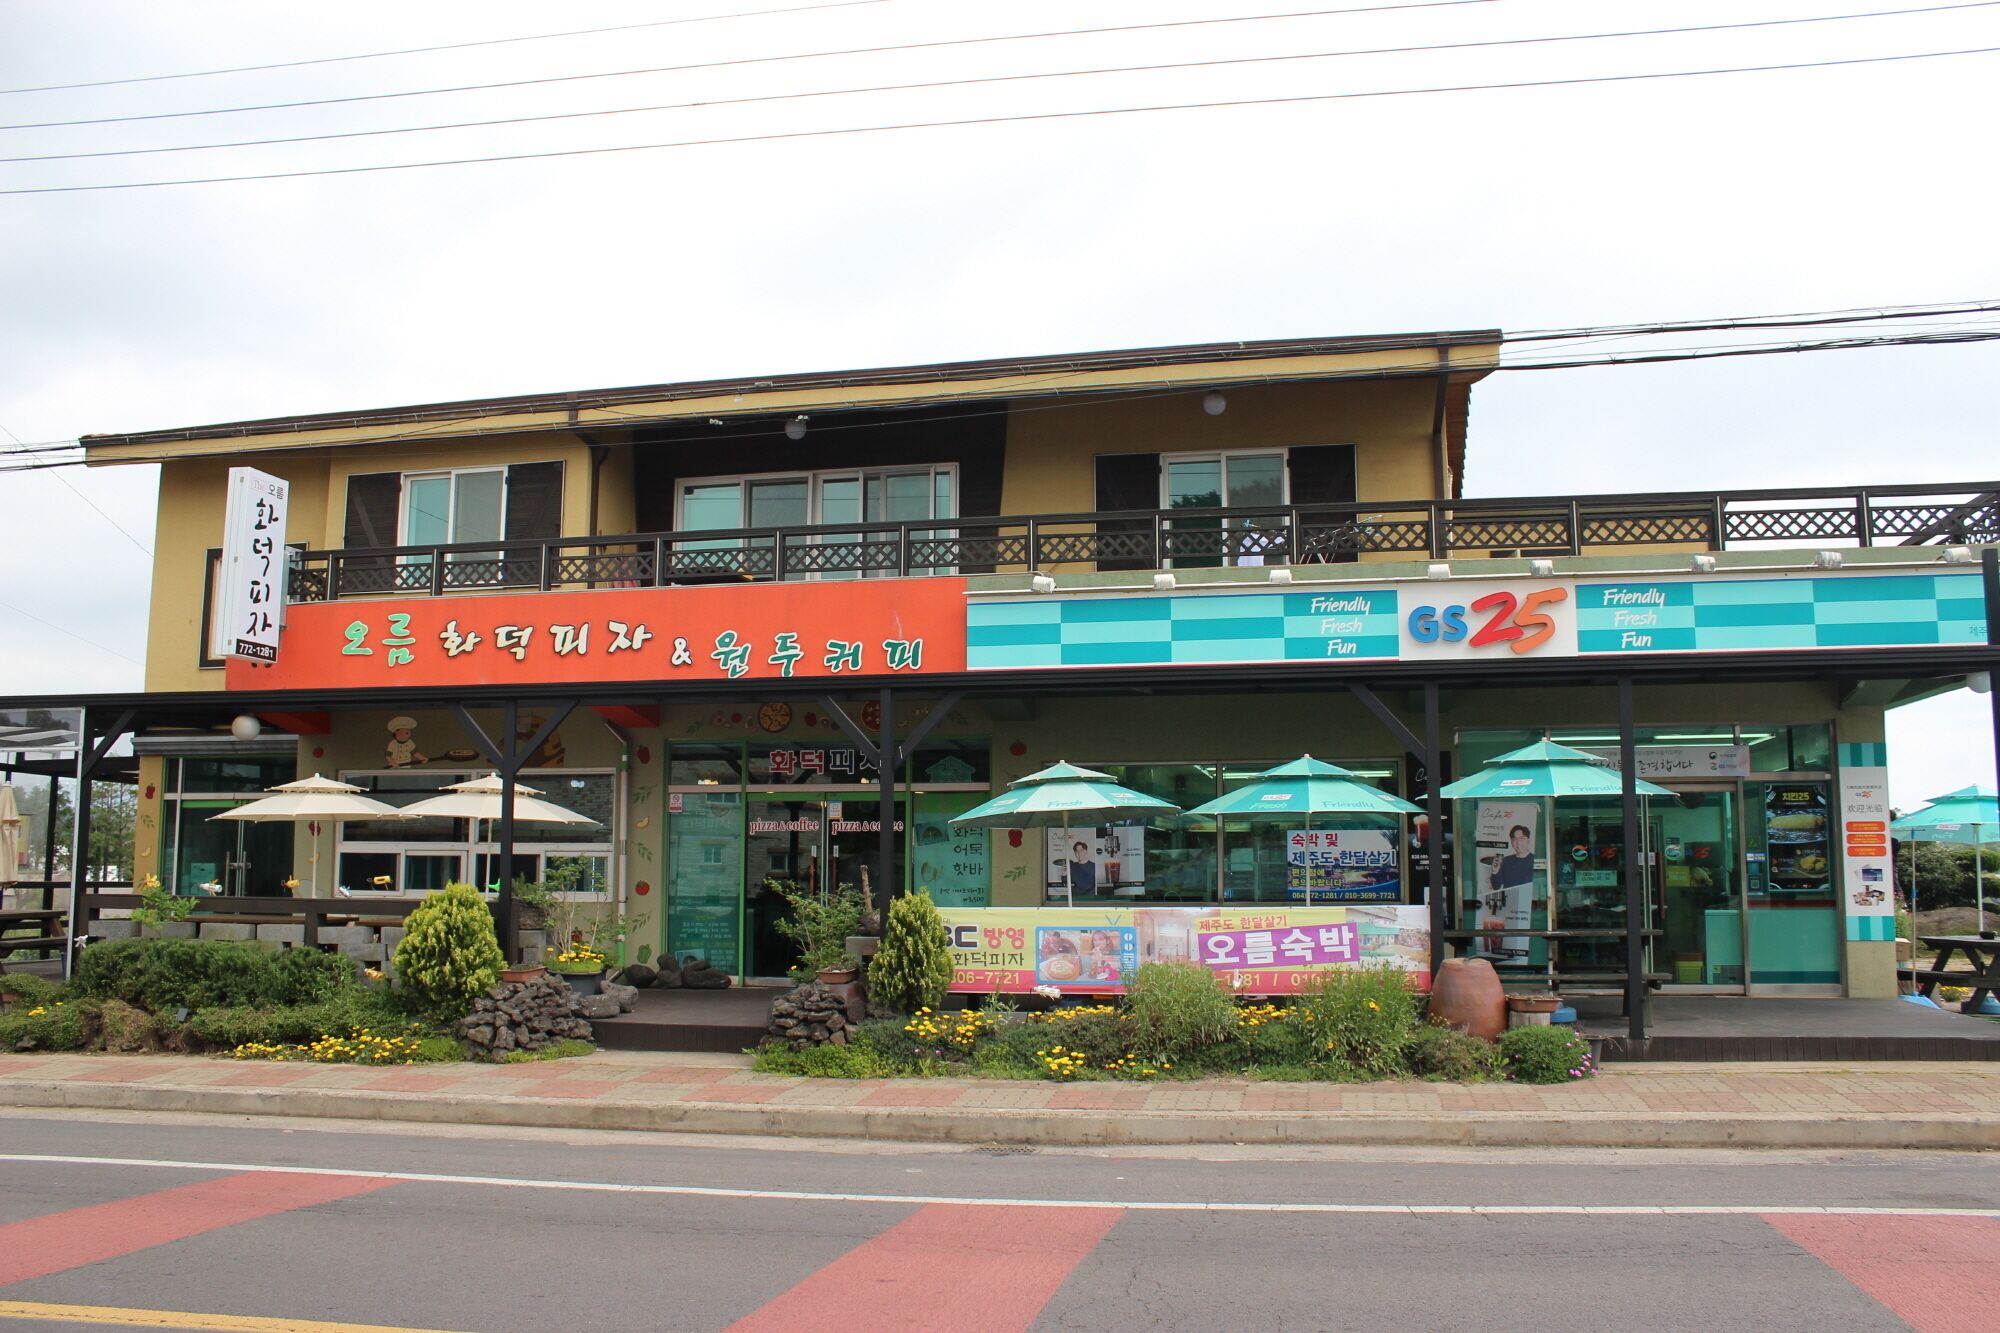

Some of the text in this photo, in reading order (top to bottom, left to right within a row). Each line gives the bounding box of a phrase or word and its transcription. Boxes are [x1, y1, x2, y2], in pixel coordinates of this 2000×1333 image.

[246, 497, 279, 637] 화덕피자
[1310, 597, 1371, 615] Friendly
[1603, 588, 1665, 607] Friendly
[1321, 618, 1362, 635] Fresh
[1408, 587, 1568, 655] GS25
[1614, 608, 1657, 628] Fresh
[341, 612, 416, 667] 오름
[671, 636, 693, 667] &
[1327, 638, 1357, 656] Fun
[1621, 630, 1652, 648] Fun
[239, 642, 274, 658] 772-1281
[1048, 800, 1082, 808] Fresh
[1321, 801, 1374, 809] Friendly
[1291, 833, 1338, 847] 숙박 및
[953, 844, 983, 856] 어묵
[1292, 851, 1334, 866] 제주도
[1339, 851, 1397, 866] 한달살기
[953, 862, 983, 876] 핫바
[1199, 915, 1287, 931] 제주도 한달살기
[942, 926, 1025, 949] BC 방영
[1204, 926, 1354, 964] 오름숙박
[953, 952, 1024, 967] 화덕피자
